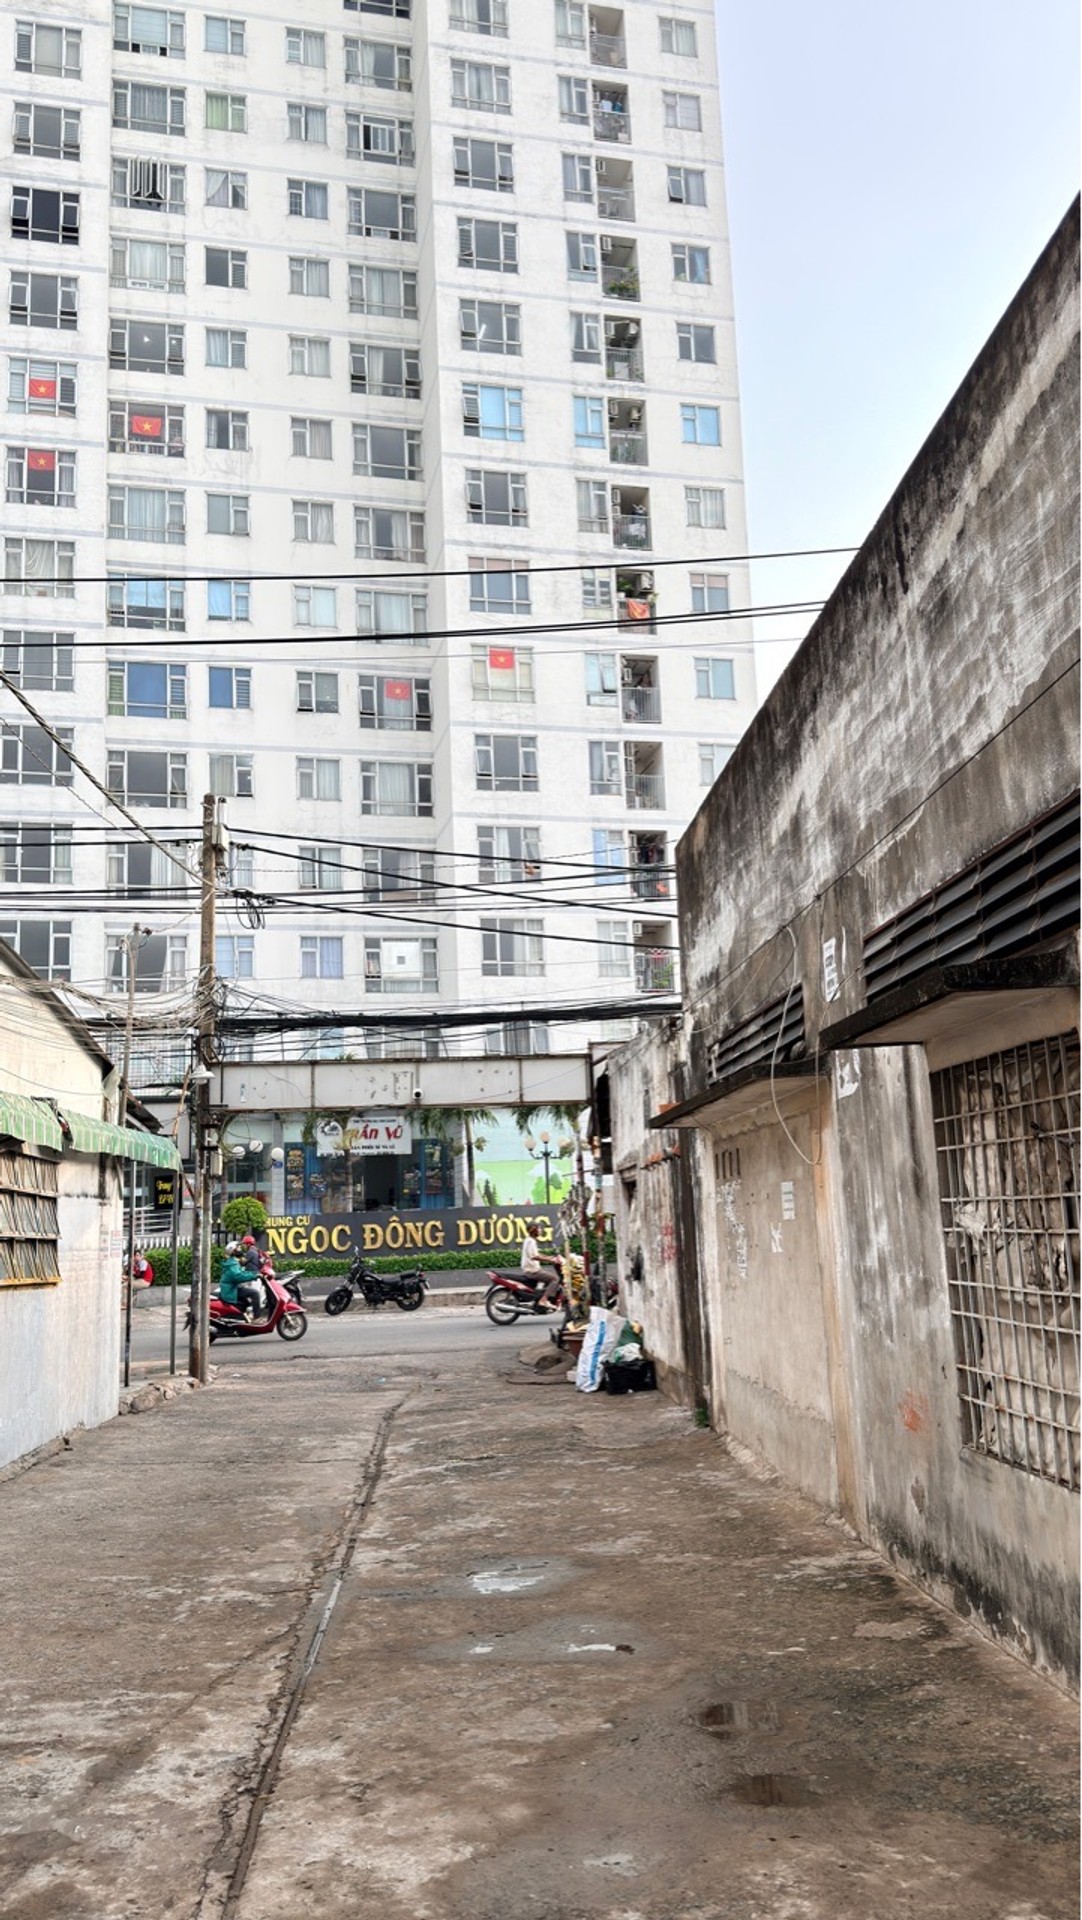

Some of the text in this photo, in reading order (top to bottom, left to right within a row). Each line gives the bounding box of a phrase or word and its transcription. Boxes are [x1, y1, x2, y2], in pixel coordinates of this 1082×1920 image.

[264, 1216, 293, 1227] HUNG
[362, 1215, 445, 1250] ĐÔNG
[456, 1213, 554, 1246] DƯƠNG
